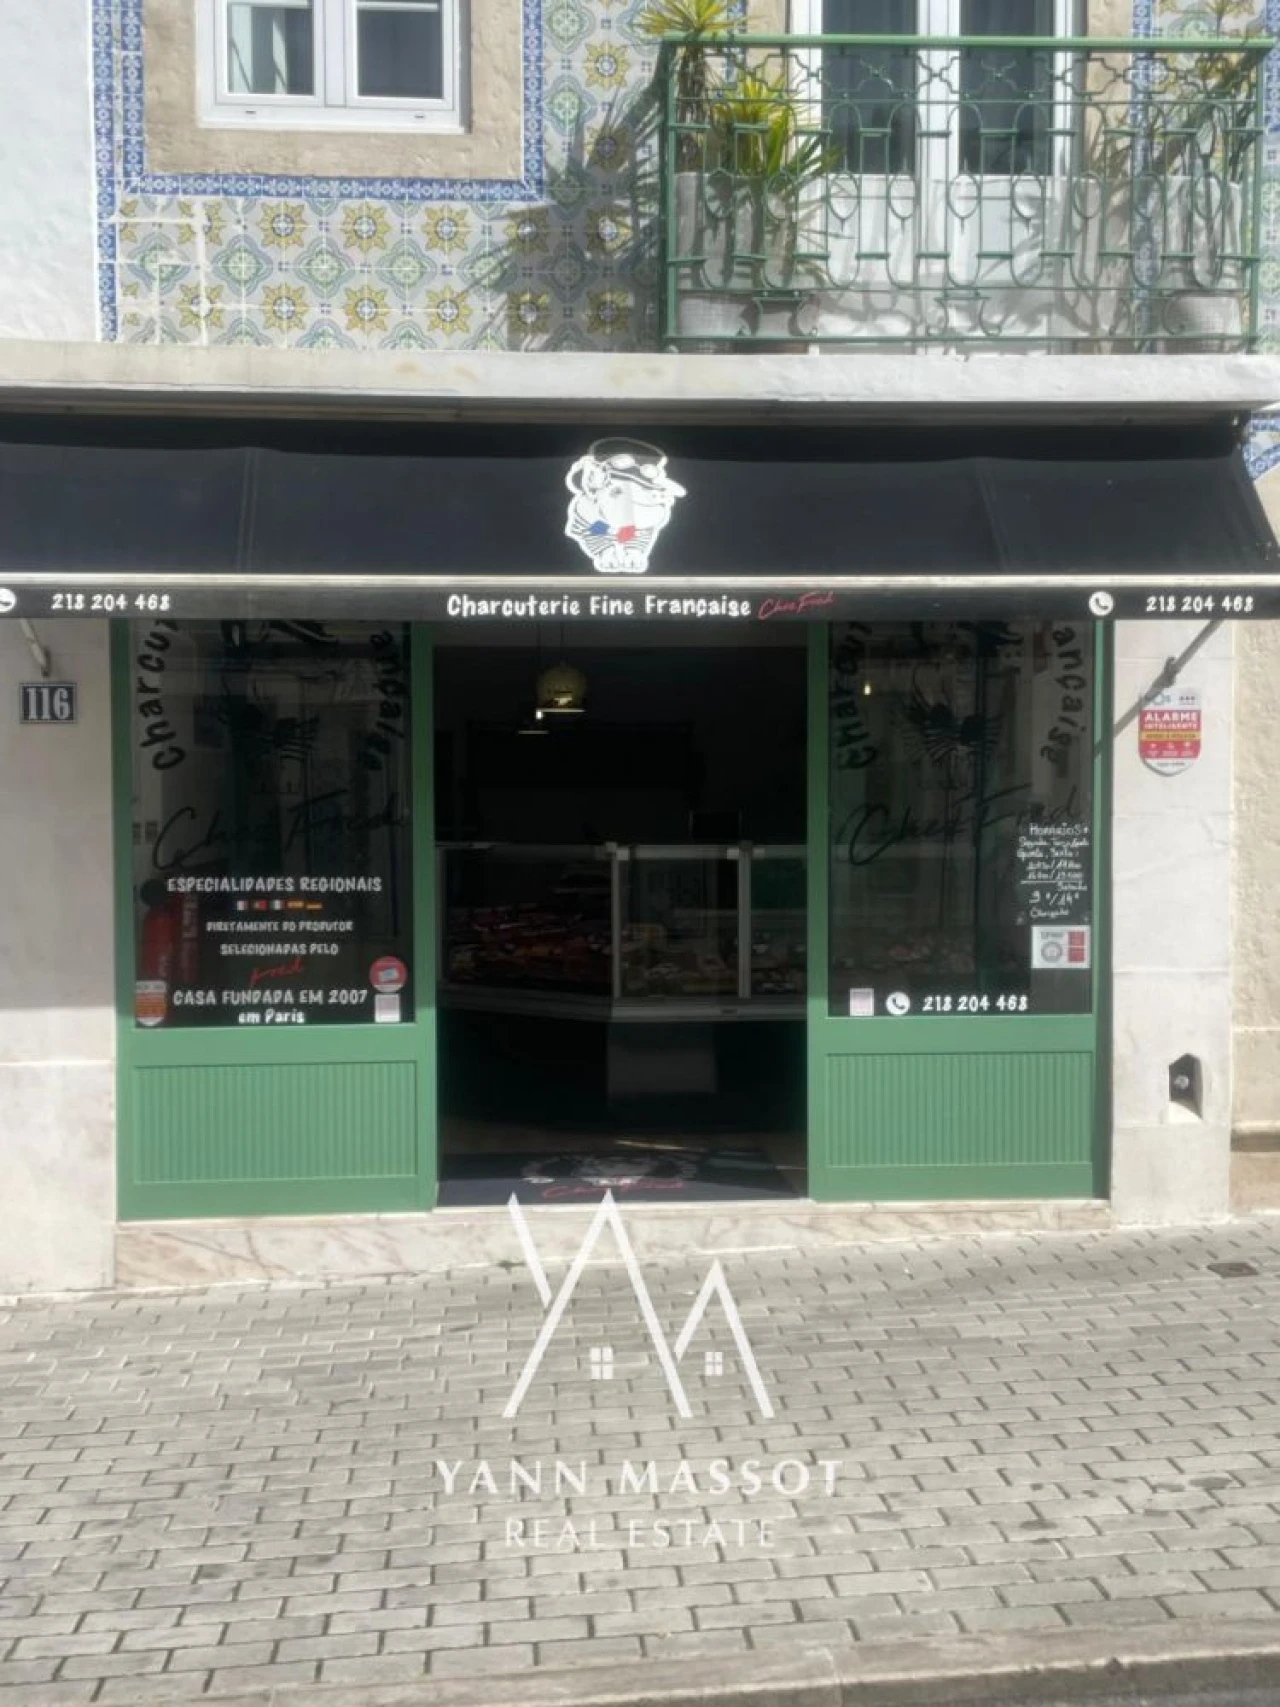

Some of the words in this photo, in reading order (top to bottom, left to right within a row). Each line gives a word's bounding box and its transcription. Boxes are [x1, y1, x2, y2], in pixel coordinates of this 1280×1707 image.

[91, 593, 127, 611] 204
[135, 593, 170, 611] 468
[447, 594, 580, 617] Charcuterie
[590, 595, 634, 616] Fine
[645, 594, 751, 617] Française
[1181, 595, 1215, 613] 204
[1221, 595, 1254, 612] 468
[27, 686, 71, 721] 116
[1145, 711, 1197, 722] ALARME
[167, 876, 294, 892] ESPECIALIDADES
[300, 876, 382, 892] REGIONAIS
[220, 943, 306, 956] SELECIONADAS
[310, 943, 338, 955] PELO
[173, 989, 216, 1005] CASA
[222, 989, 294, 1005] FUNDADA
[299, 989, 323, 1005] EM
[328, 989, 368, 1005] 2007
[957, 995, 990, 1012] 204
[996, 995, 1028, 1012] 468
[238, 1012, 260, 1024] em
[265, 1008, 305, 1024] Paris
